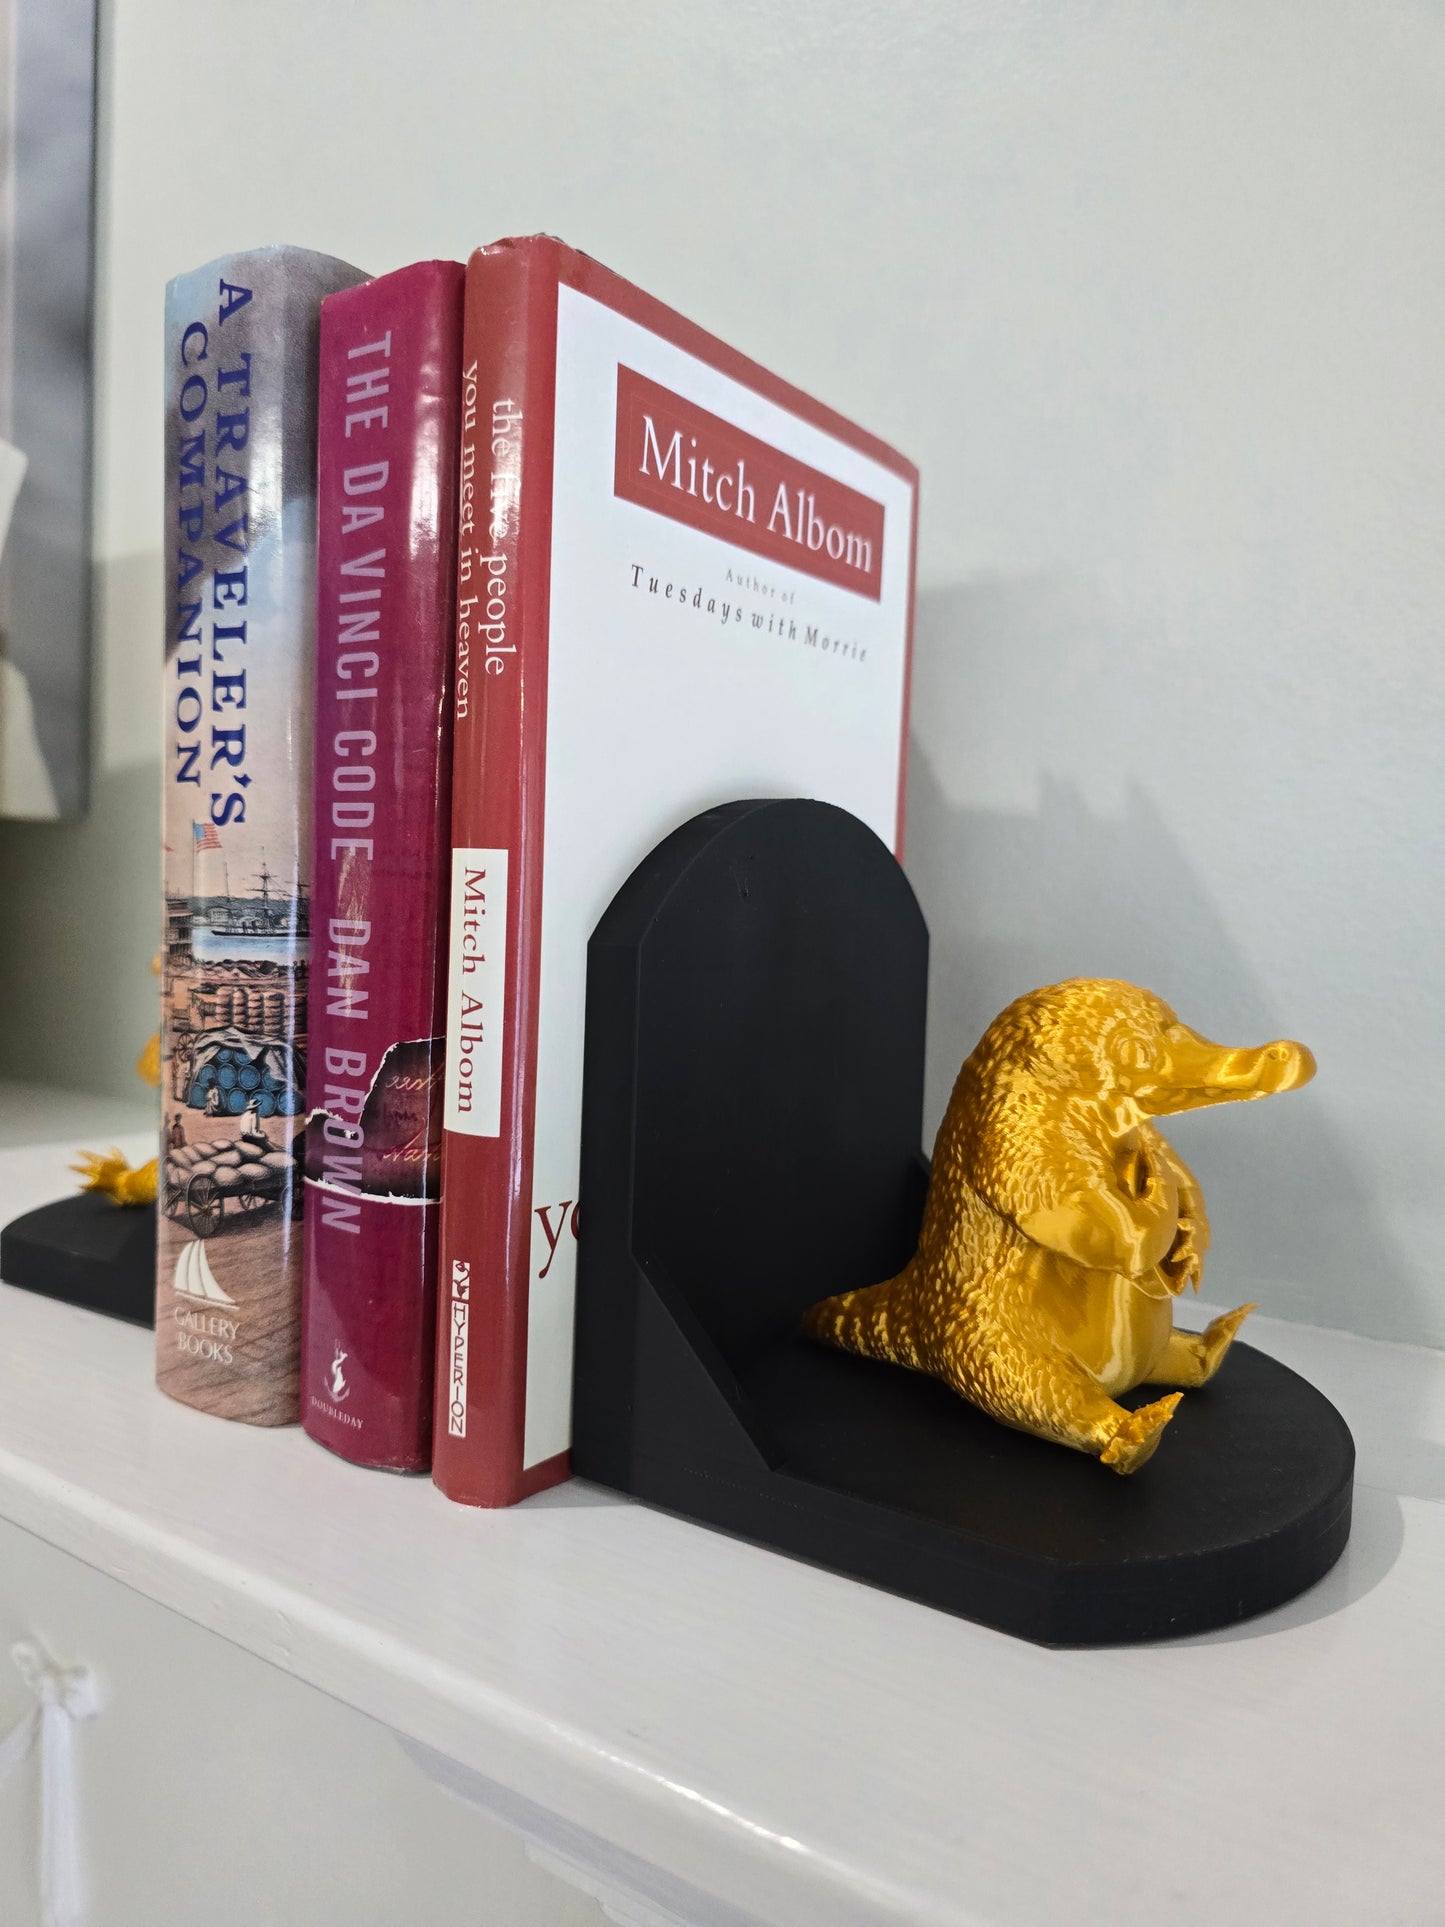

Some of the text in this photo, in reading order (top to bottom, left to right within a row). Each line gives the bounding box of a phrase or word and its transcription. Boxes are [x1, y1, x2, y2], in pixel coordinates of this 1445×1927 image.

[491, 398, 523, 457] the
[176, 321, 209, 786] COMPANION
[210, 278, 253, 828] A TRAVELER'S
[457, 360, 479, 720] you meet in heaven
[638, 414, 872, 574] Mitch Albom
[330, 330, 392, 861] THE DA VINCI CODE
[477, 553, 517, 675] people
[631, 564, 868, 662] Tuesdays with Morrie
[725, 568, 796, 605] Author of
[457, 866, 487, 1114] Mitch Albom
[322, 918, 371, 1234] DAN BROWN
[174, 1306, 240, 1340] GALLERY
[177, 1331, 234, 1364] BOOKS
[451, 1305, 466, 1434] HYPERION
[311, 1396, 364, 1429] DOUBLEDAY
